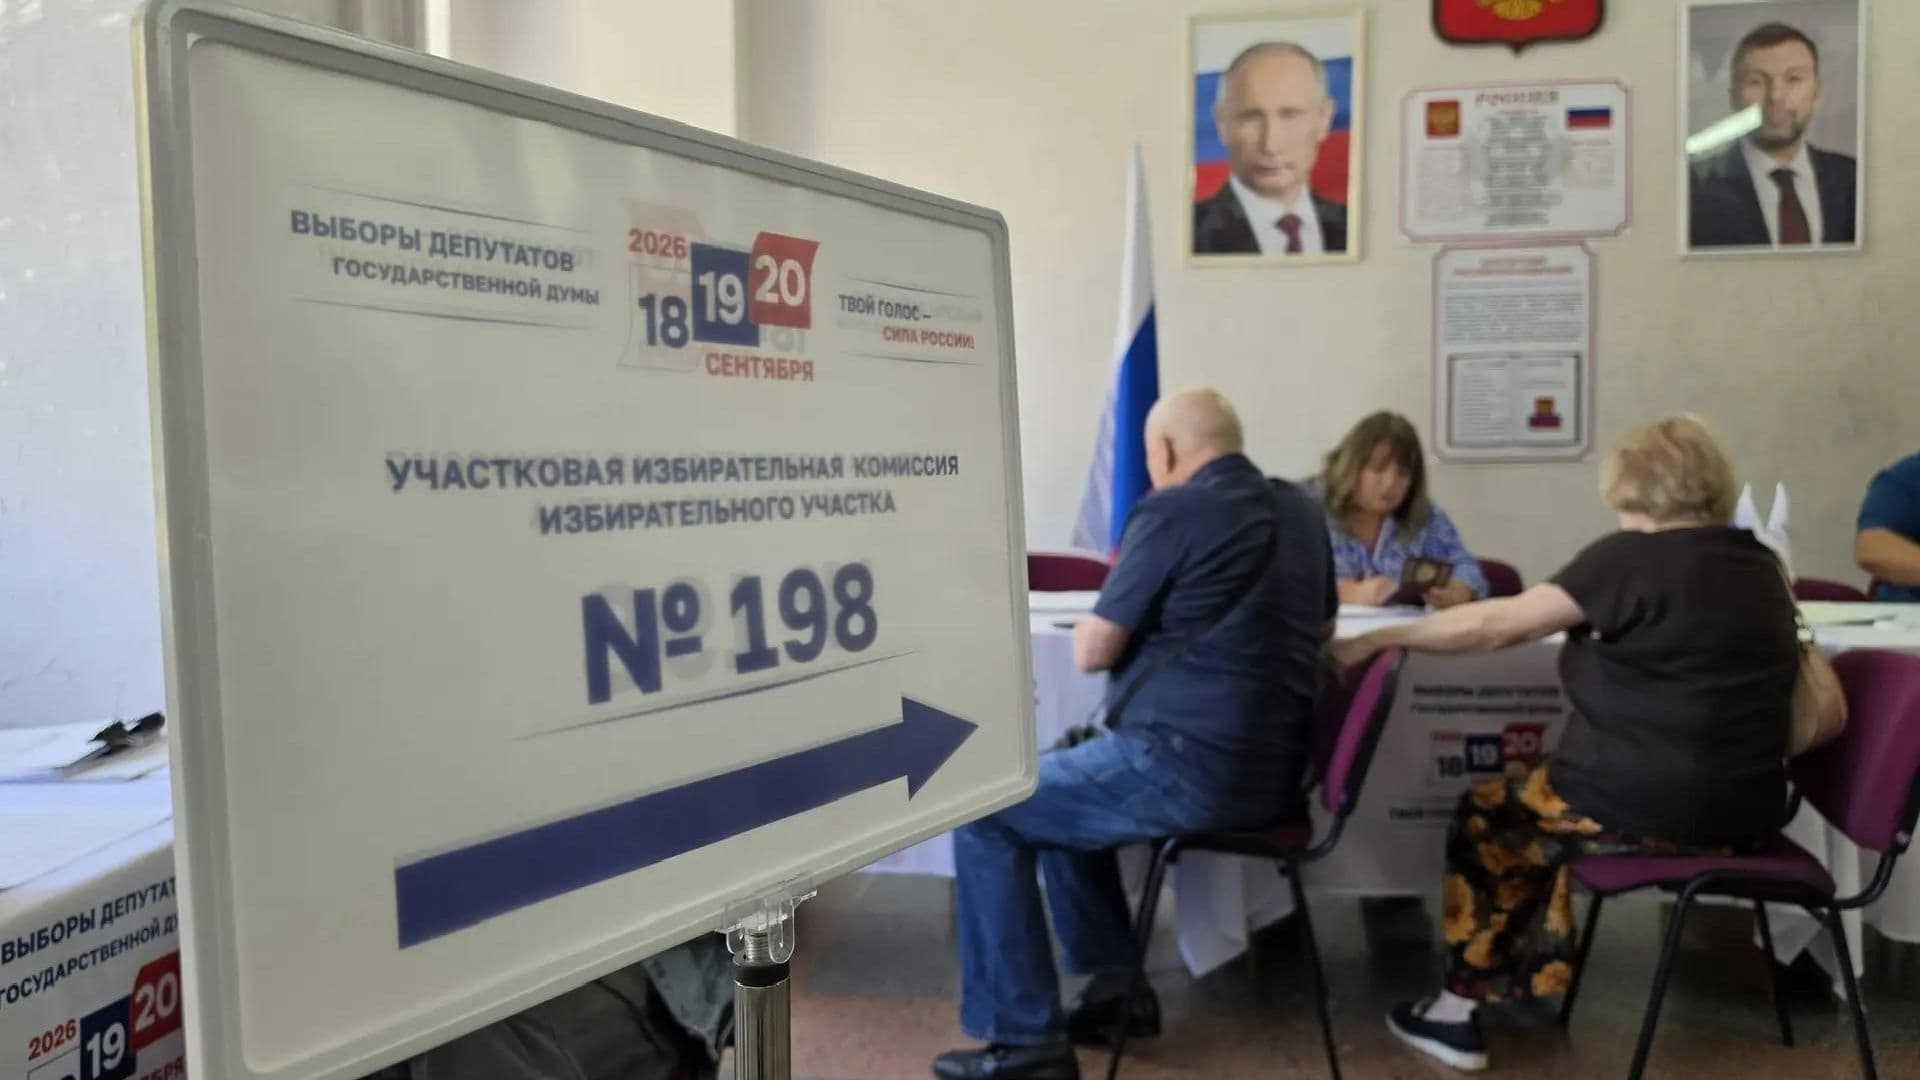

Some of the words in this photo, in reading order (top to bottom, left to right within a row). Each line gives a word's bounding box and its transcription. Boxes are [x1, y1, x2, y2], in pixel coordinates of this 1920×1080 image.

[290, 209, 421, 251] ВЫБОРЫ
[429, 231, 575, 272] ДЕПУТАТОВ
[628, 228, 688, 260] 2026
[333, 256, 542, 299] ГОСУДАРСТВЕННОЙ
[545, 284, 600, 306] ДУМЫ
[699, 271, 745, 325] 19
[754, 254, 806, 306] 20
[638, 293, 690, 349] 18
[838, 293, 875, 316] ТВОЙ
[878, 299, 920, 321] ГОЛОС
[882, 326, 918, 344] СИЛА
[921, 330, 975, 350] РОССИИ!
[705, 352, 815, 382] СЕНТЯБРЯ
[387, 456, 625, 492] УЧАСТКОВАЯ
[632, 456, 844, 485] ИЗБИРАТЕЛЬНАЯ
[853, 455, 960, 479] КОМИССИЯ
[538, 495, 794, 535] ИЗБИРАТЕЛЬНОГО
[801, 491, 896, 519] УЧАСТКА
[581, 582, 704, 706] №
[730, 562, 880, 675] 198
[1, 908, 95, 965] ВЫБОРЫ
[100, 876, 176, 930] ДЕПУТАТ
[135, 972, 178, 1032] 20
[28, 1018, 77, 1061] 2026
[86, 1022, 126, 1079] 19
